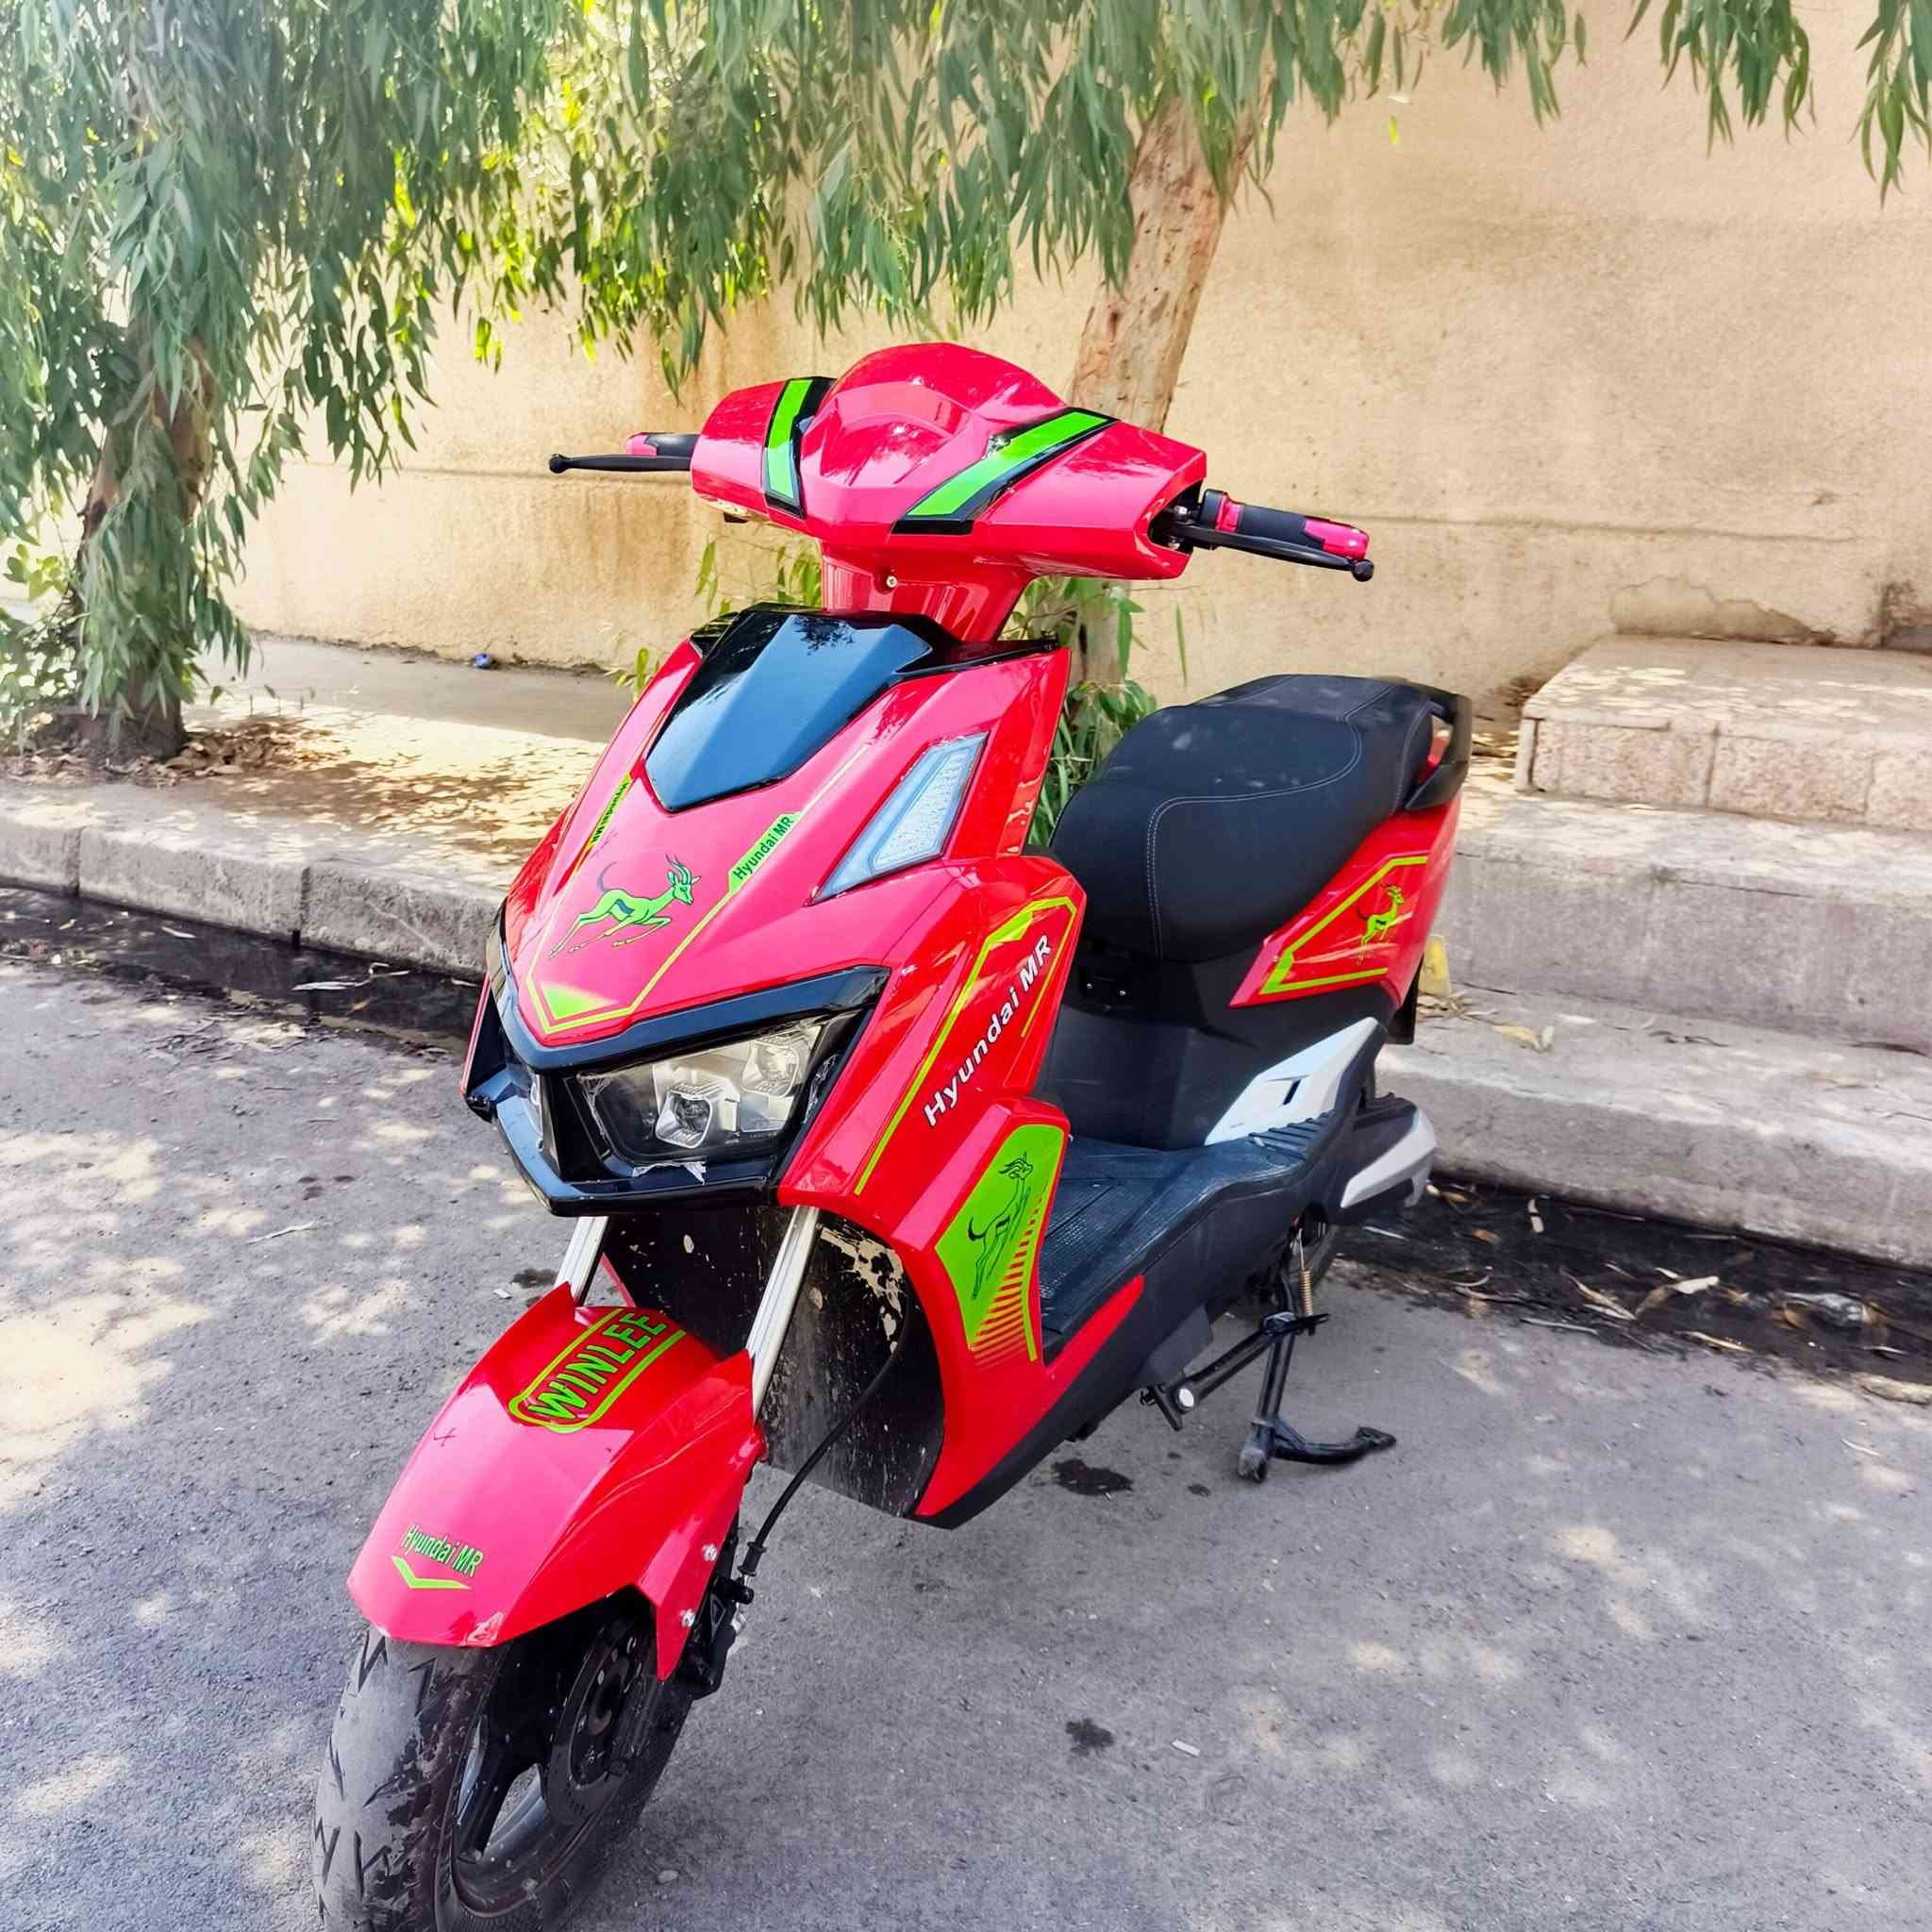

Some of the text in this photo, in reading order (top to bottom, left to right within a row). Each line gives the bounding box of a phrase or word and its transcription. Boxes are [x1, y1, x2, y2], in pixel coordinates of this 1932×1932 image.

[733, 816, 794, 880] Hyundai MR
[924, 935, 1051, 1126] Hyundai MR
[526, 1312, 667, 1419] WINLEE
[400, 1524, 483, 1577] Hyundai MR
